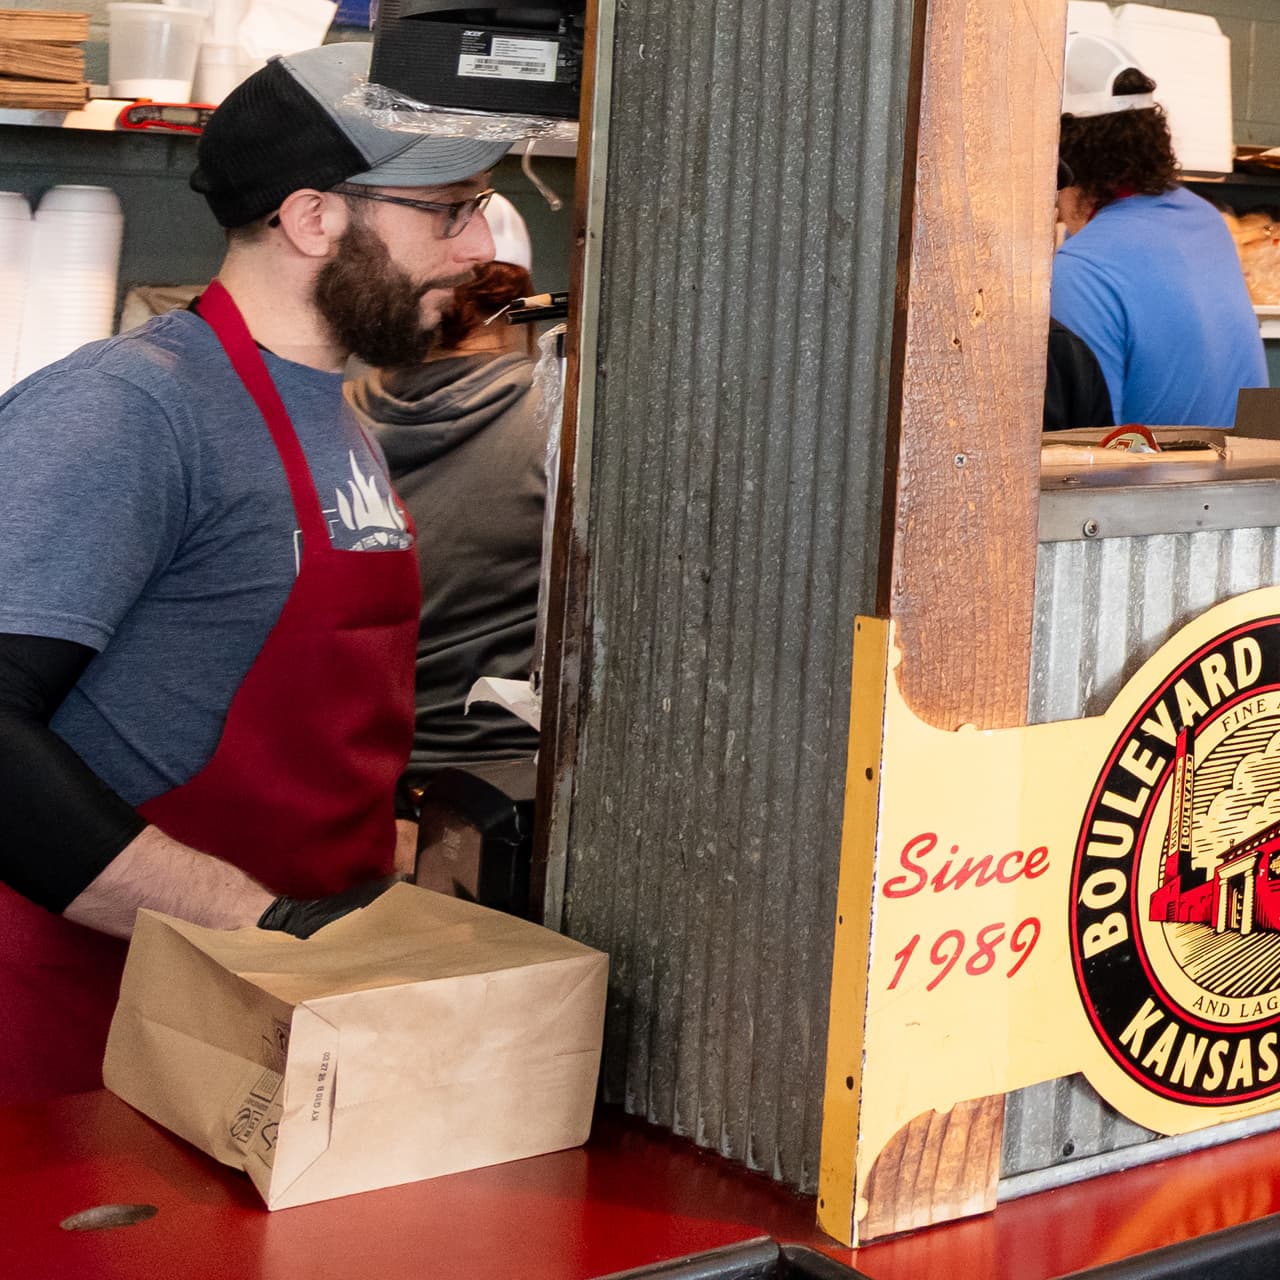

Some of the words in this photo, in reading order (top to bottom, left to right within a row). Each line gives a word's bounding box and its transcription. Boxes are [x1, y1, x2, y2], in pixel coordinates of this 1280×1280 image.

[1221, 698, 1267, 733] FINE
[1082, 635, 1262, 962] BOULEVARD
[881, 831, 1050, 901] Since
[885, 916, 1042, 992] 1989
[1193, 995, 1230, 1019] AND
[1118, 995, 1279, 1094] KANSAS
